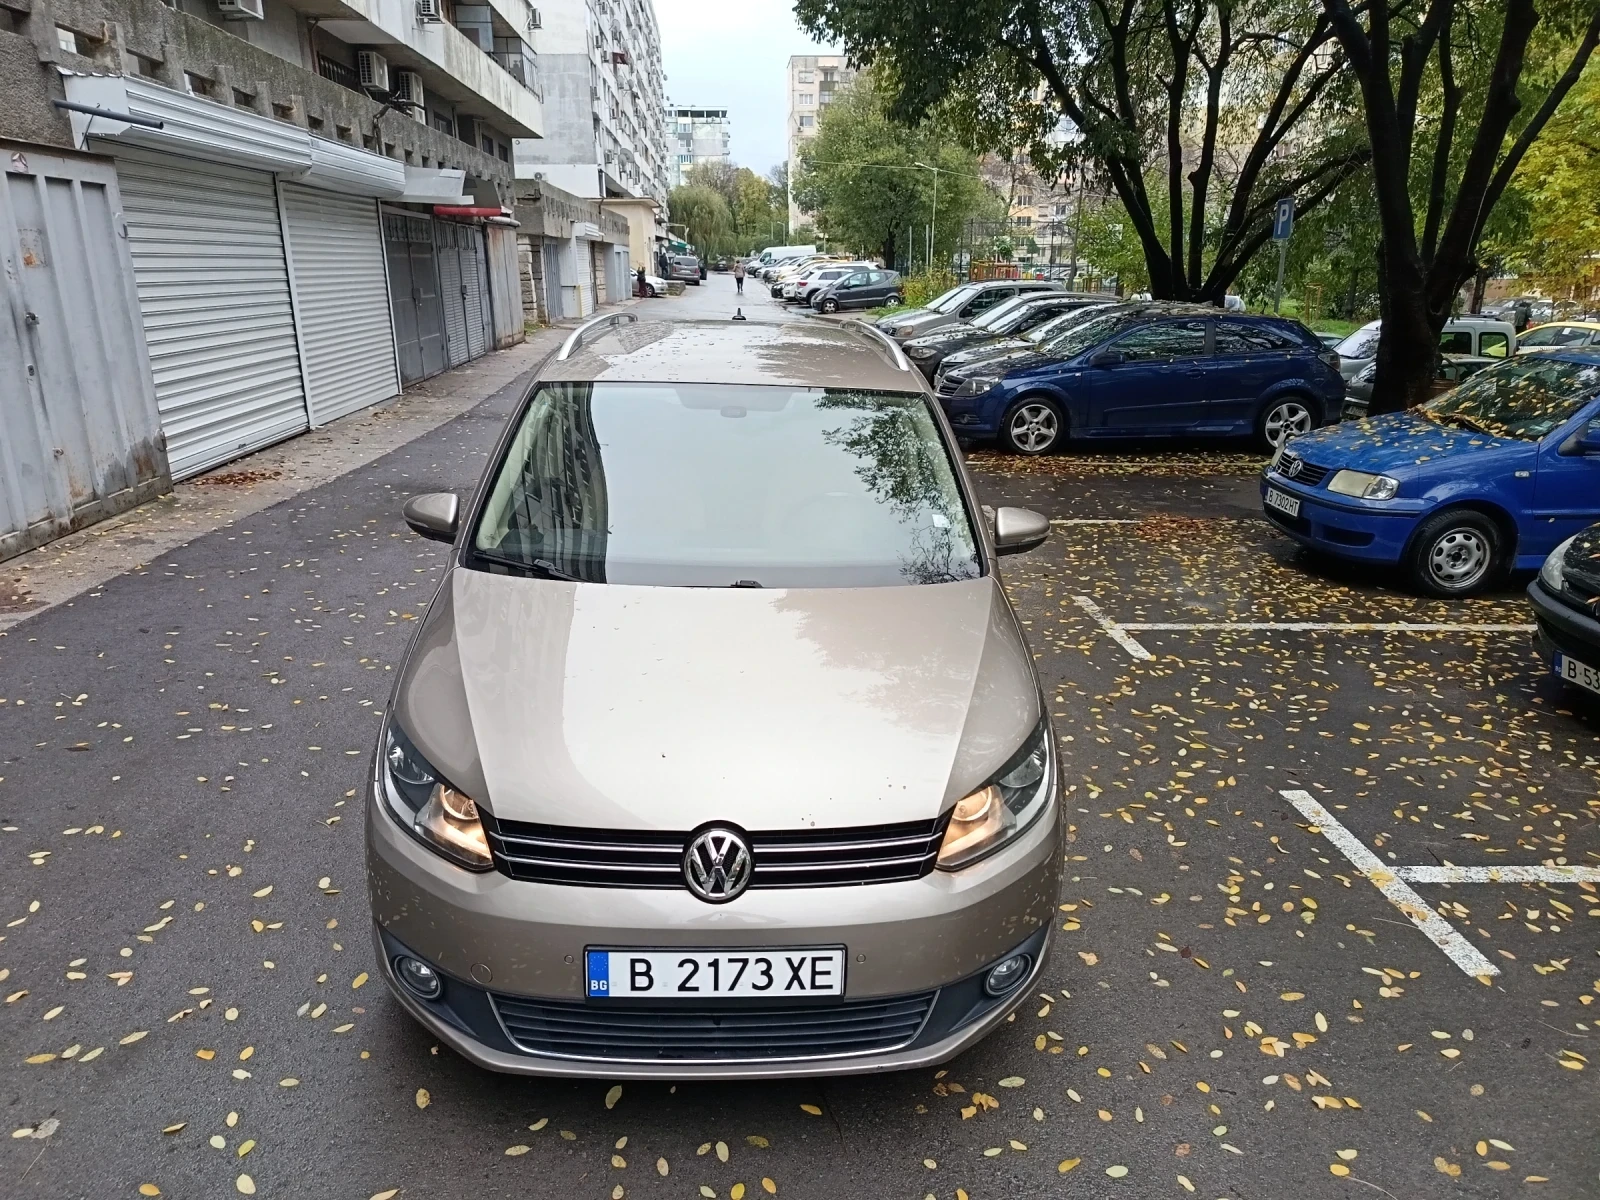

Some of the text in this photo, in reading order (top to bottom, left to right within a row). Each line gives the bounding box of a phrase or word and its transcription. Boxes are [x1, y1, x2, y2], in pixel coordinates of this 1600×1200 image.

[1277, 204, 1289, 235] P
[1268, 490, 1274, 503] B
[1567, 660, 1577, 679] B
[629, 956, 834, 992] B 2173 XE
[590, 979, 608, 991] BG
